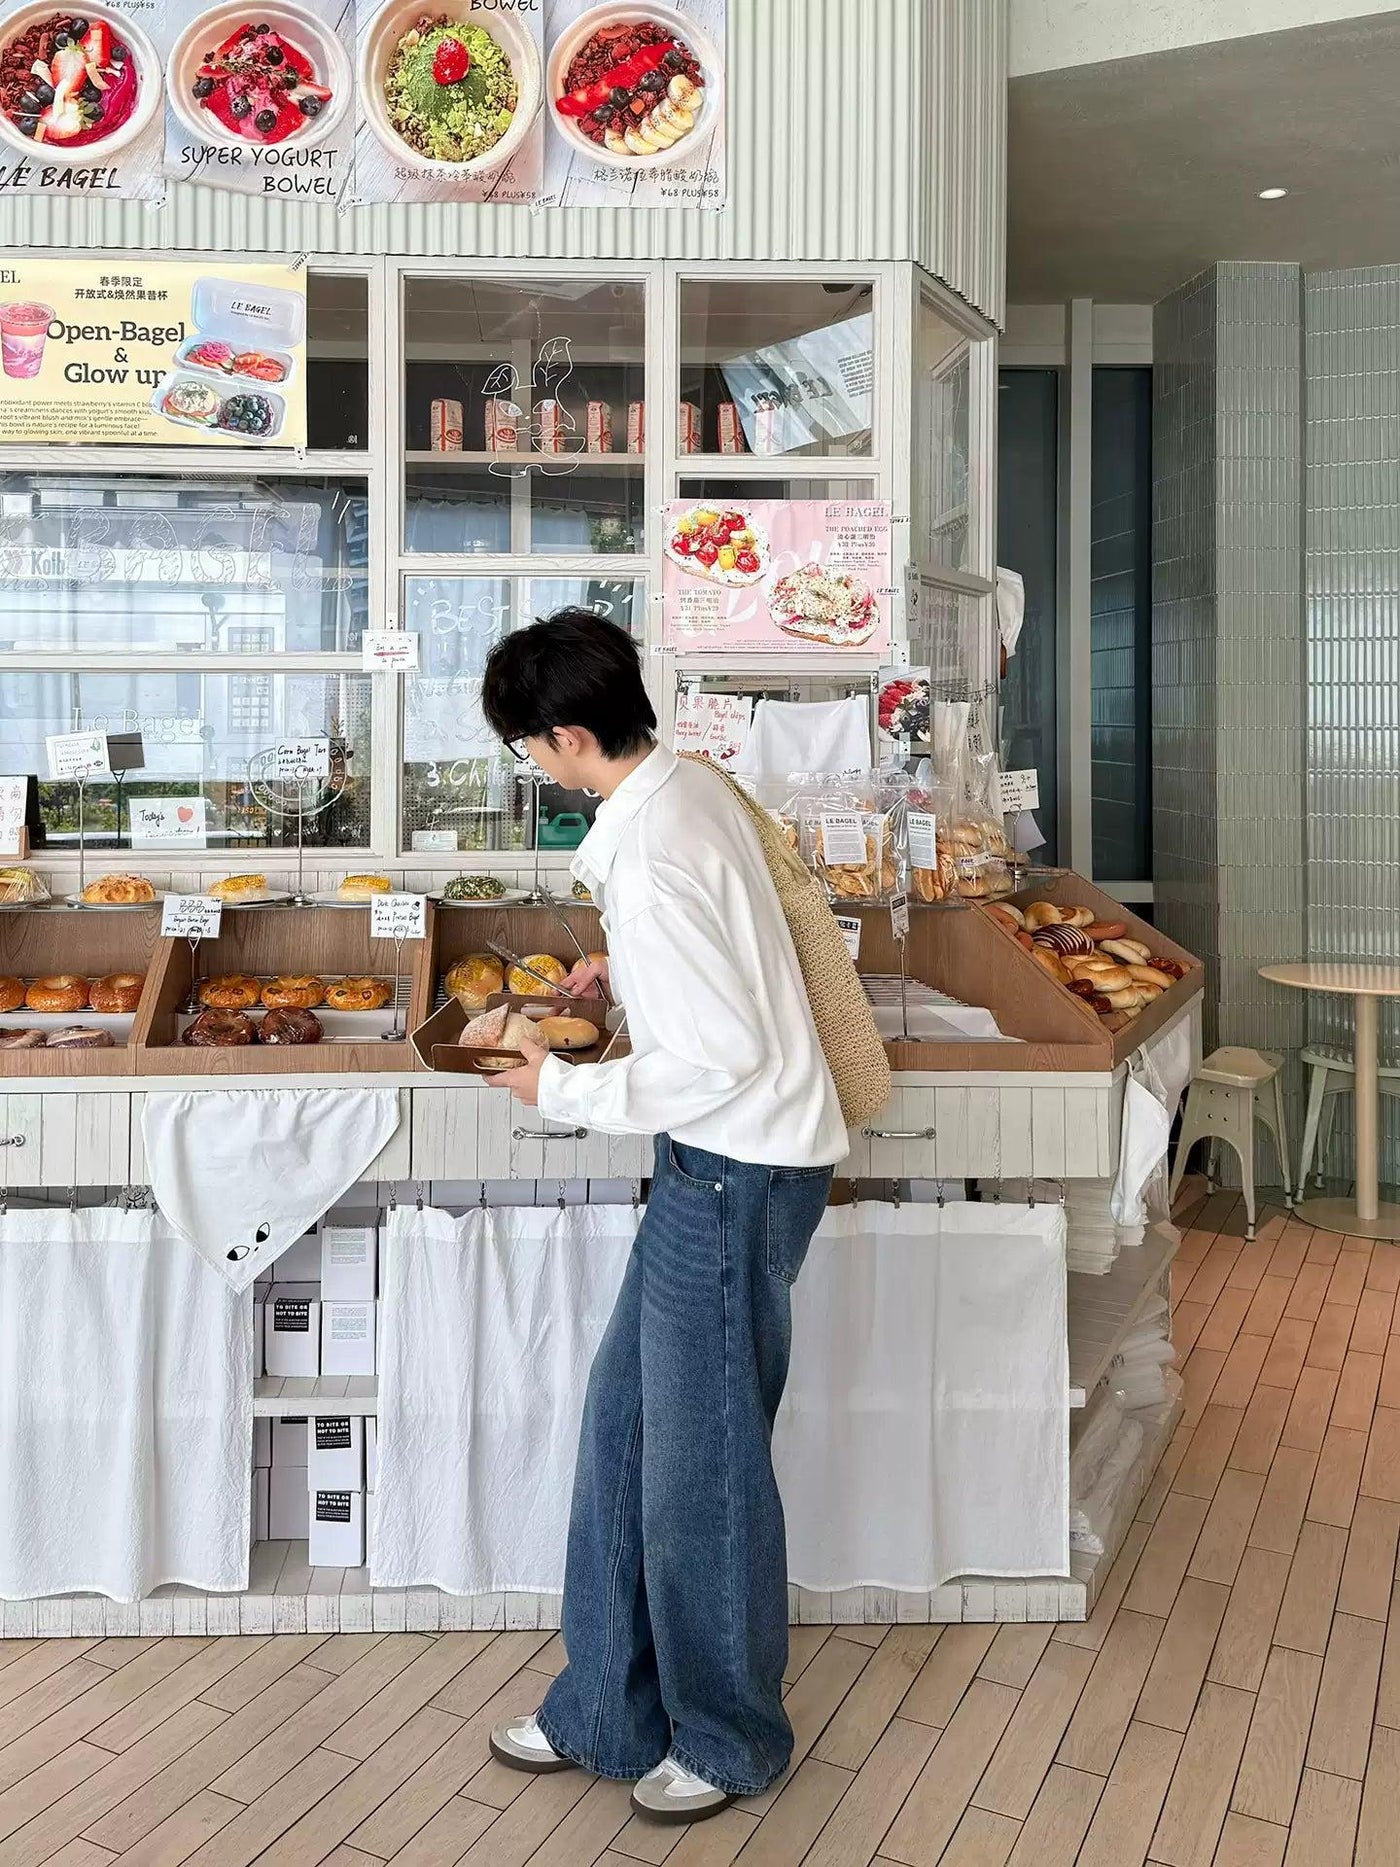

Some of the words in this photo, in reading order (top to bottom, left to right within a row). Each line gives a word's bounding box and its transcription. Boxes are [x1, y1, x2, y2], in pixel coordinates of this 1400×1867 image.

[181, 147, 242, 166] SUPER
[251, 148, 338, 169] YOGURT
[39, 166, 122, 189] BAGEL
[263, 177, 337, 196] BOWEL
[660, 187, 679, 197] ¥68
[100, 276, 142, 287] 春季限定
[231, 301, 243, 310] LE
[245, 303, 272, 315] BAGEL
[46, 319, 186, 345] Open-Bagel
[114, 348, 128, 363] &
[64, 363, 128, 384] Glow
[136, 368, 168, 387] up
[430, 595, 511, 637] BEST
[679, 695, 733, 711] 贝果脆片
